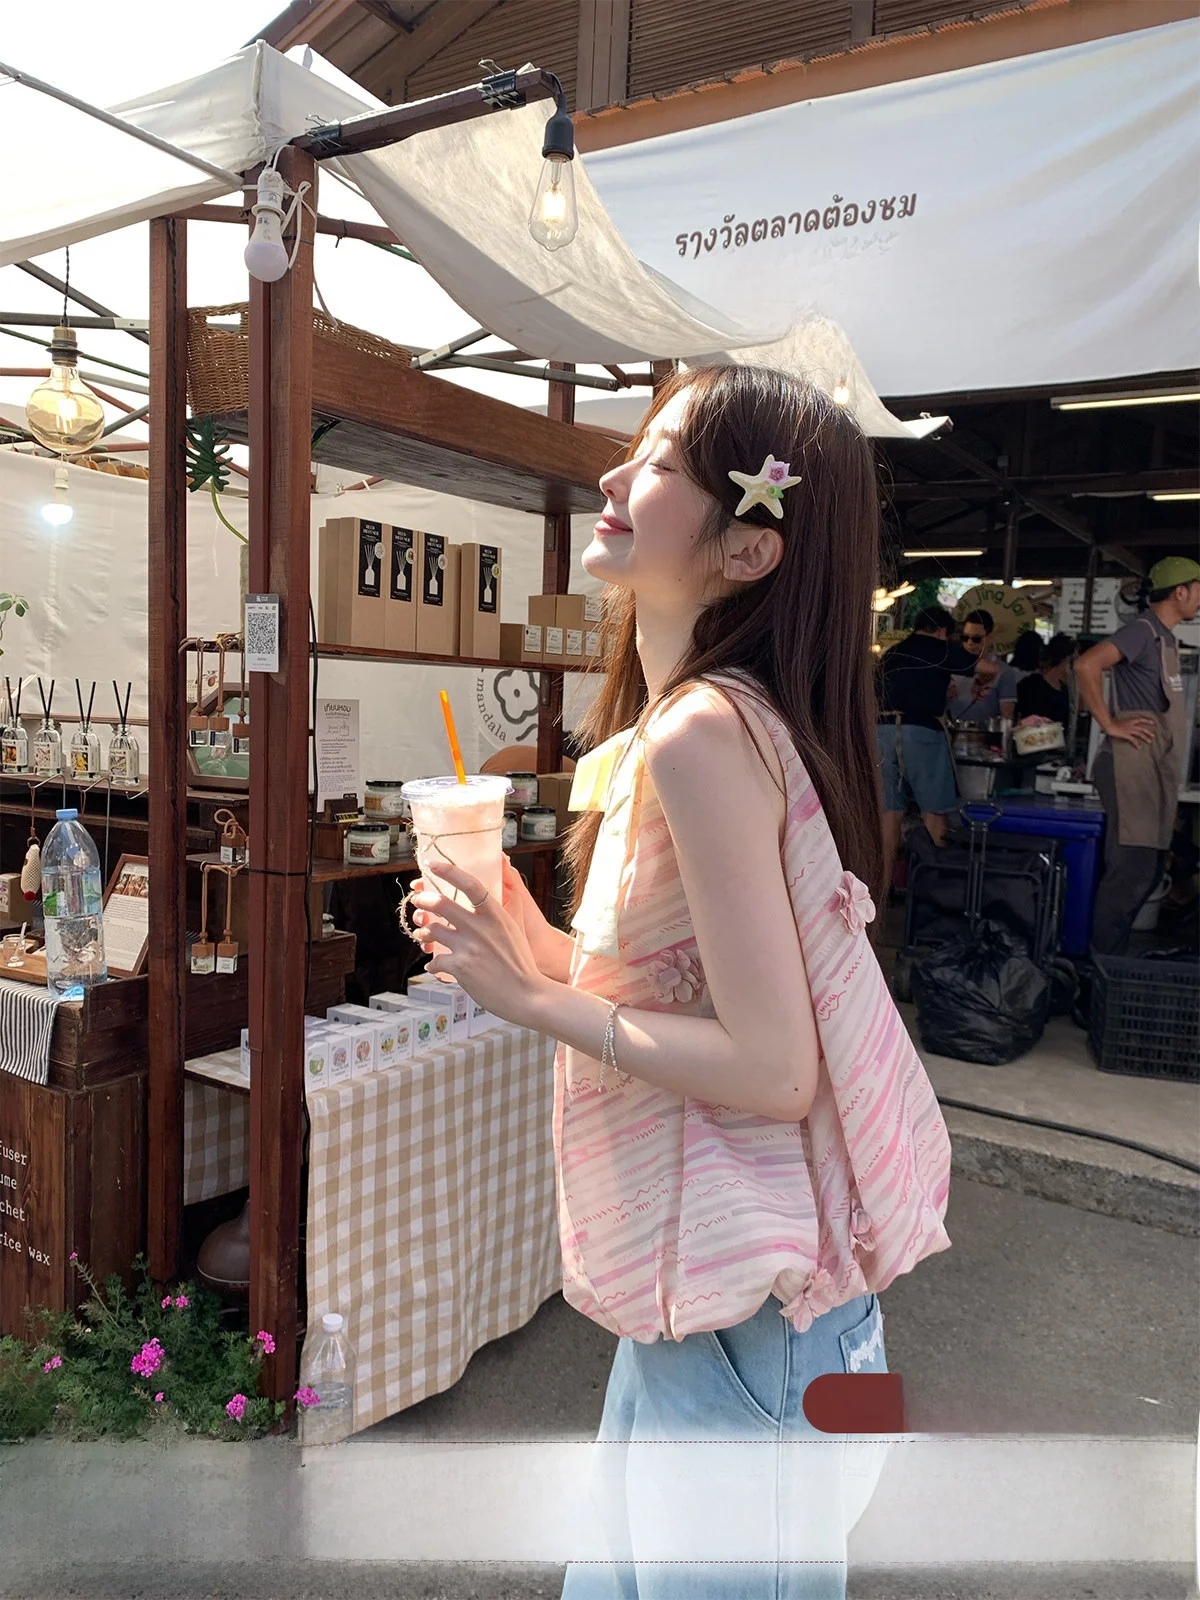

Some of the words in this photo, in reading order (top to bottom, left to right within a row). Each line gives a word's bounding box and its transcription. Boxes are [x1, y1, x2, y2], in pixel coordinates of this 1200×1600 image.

[675, 193, 917, 260] รางวัลตลาดต้องชม
[476, 677, 507, 743] mandala
[0, 1199, 26, 1222] chet
[28, 1245, 51, 1266] wax
